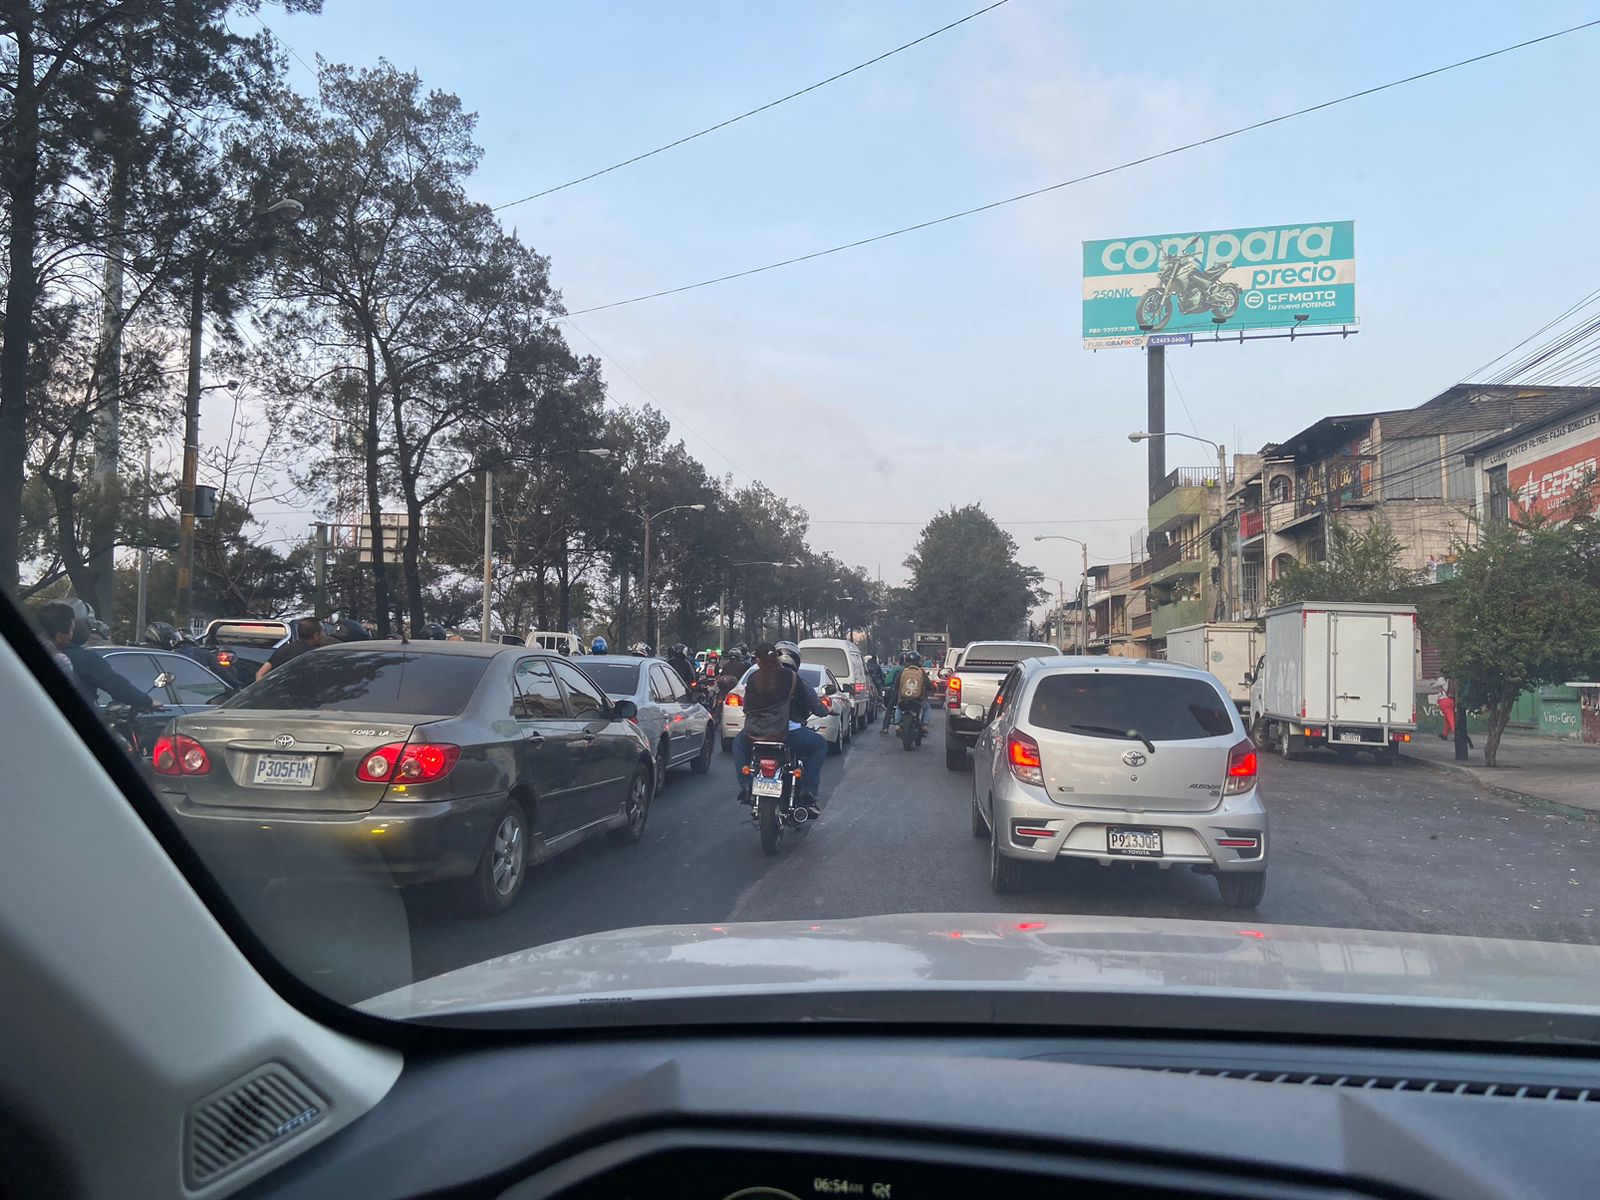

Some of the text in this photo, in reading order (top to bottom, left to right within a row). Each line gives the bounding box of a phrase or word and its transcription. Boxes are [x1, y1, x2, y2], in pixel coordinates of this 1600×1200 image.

[1101, 226, 1334, 271] compara
[1251, 261, 1336, 289] precio
[1092, 287, 1134, 299] 250NK
[1267, 290, 1336, 302] CFMOTO
[1301, 301, 1336, 309] POTENCIA
[1490, 443, 1528, 464] LUBRICANTES
[1528, 433, 1549, 449] FILTROS
[1549, 425, 1567, 441] FAJAS
[814, 1177, 848, 1194] 06:54
